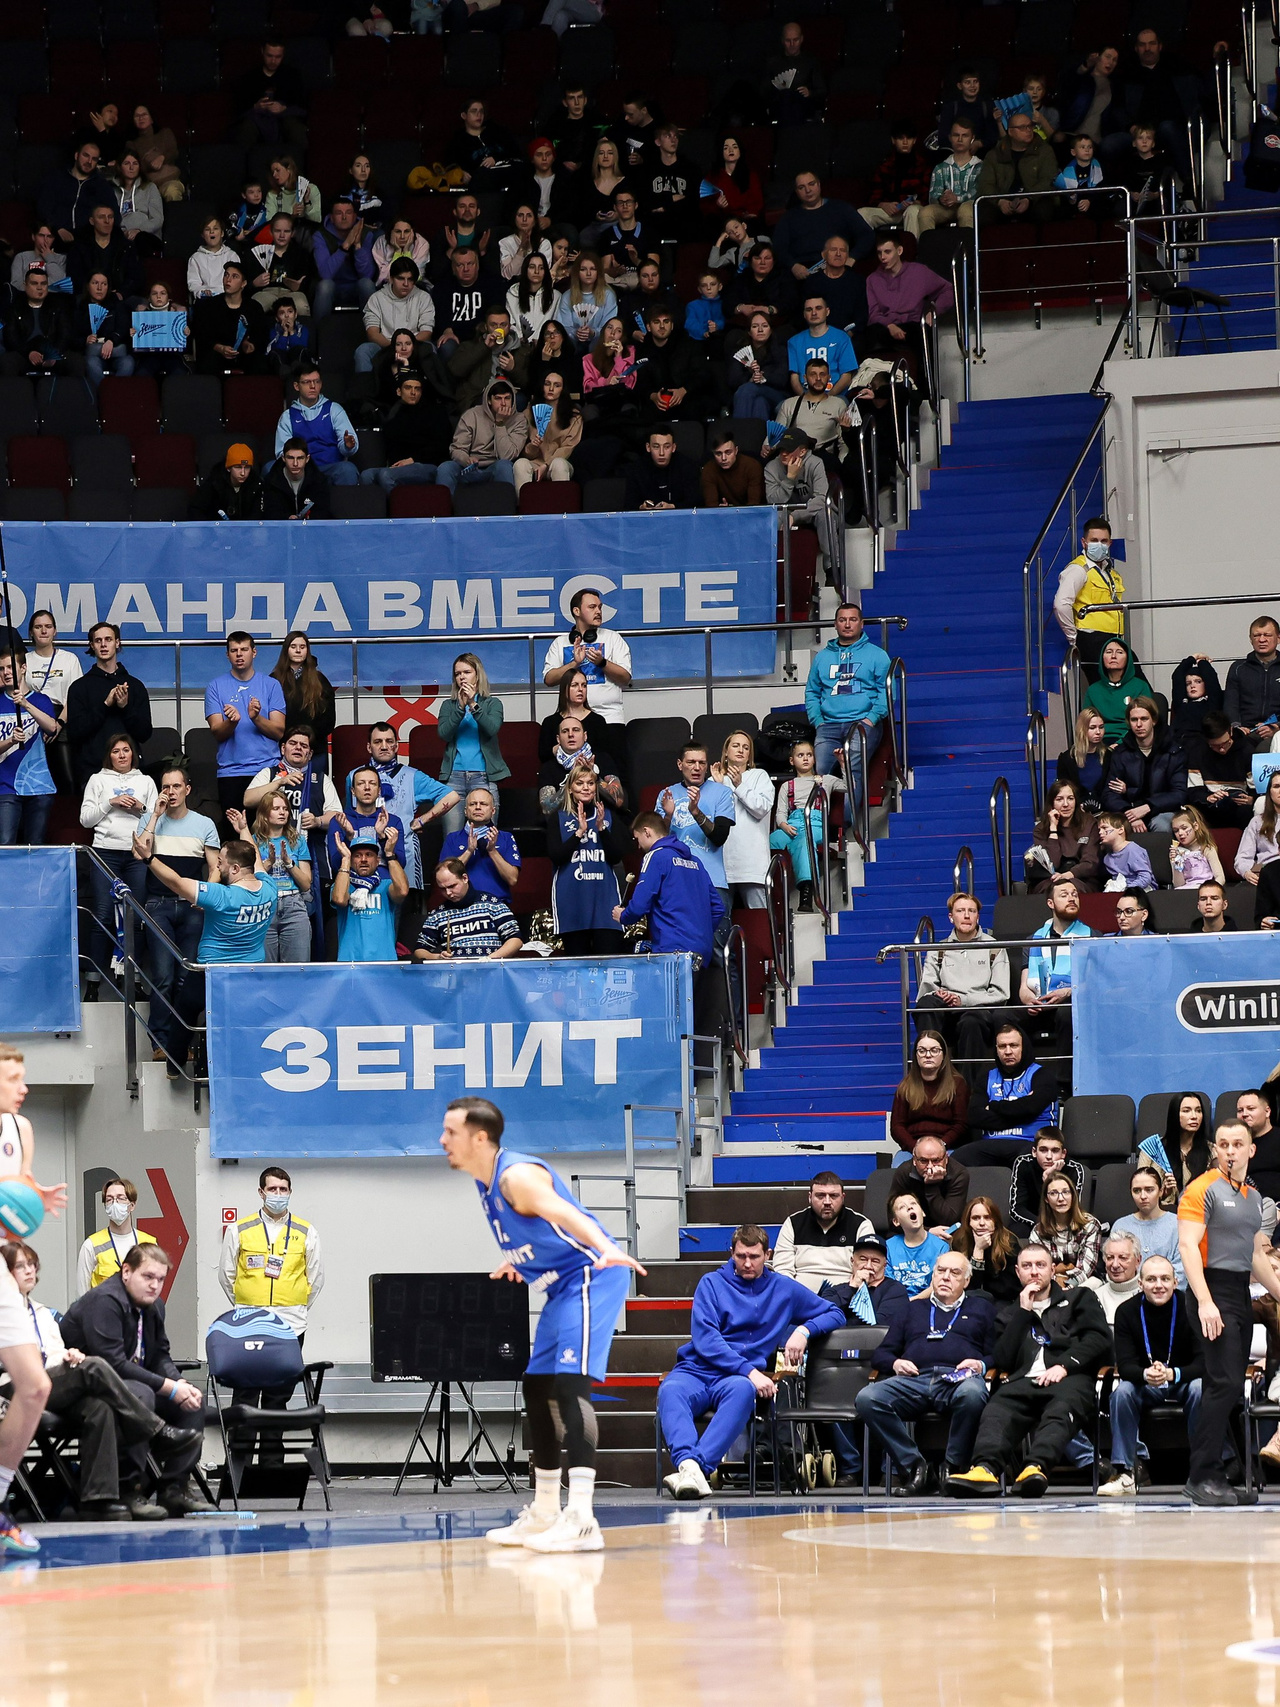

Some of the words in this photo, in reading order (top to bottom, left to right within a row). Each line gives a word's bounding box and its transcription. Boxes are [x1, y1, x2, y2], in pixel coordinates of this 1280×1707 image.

[652, 176, 687, 194] GAP
[452, 292, 482, 322] GAP
[367, 570, 739, 631] ВМЕСТЕ
[284, 789, 302, 806] 78
[443, 919, 490, 938] ЗЕНИТ
[260, 1018, 642, 1092] ЗЕНИТ
[244, 1341, 265, 1350] 57
[846, 1349, 855, 1358] 11
